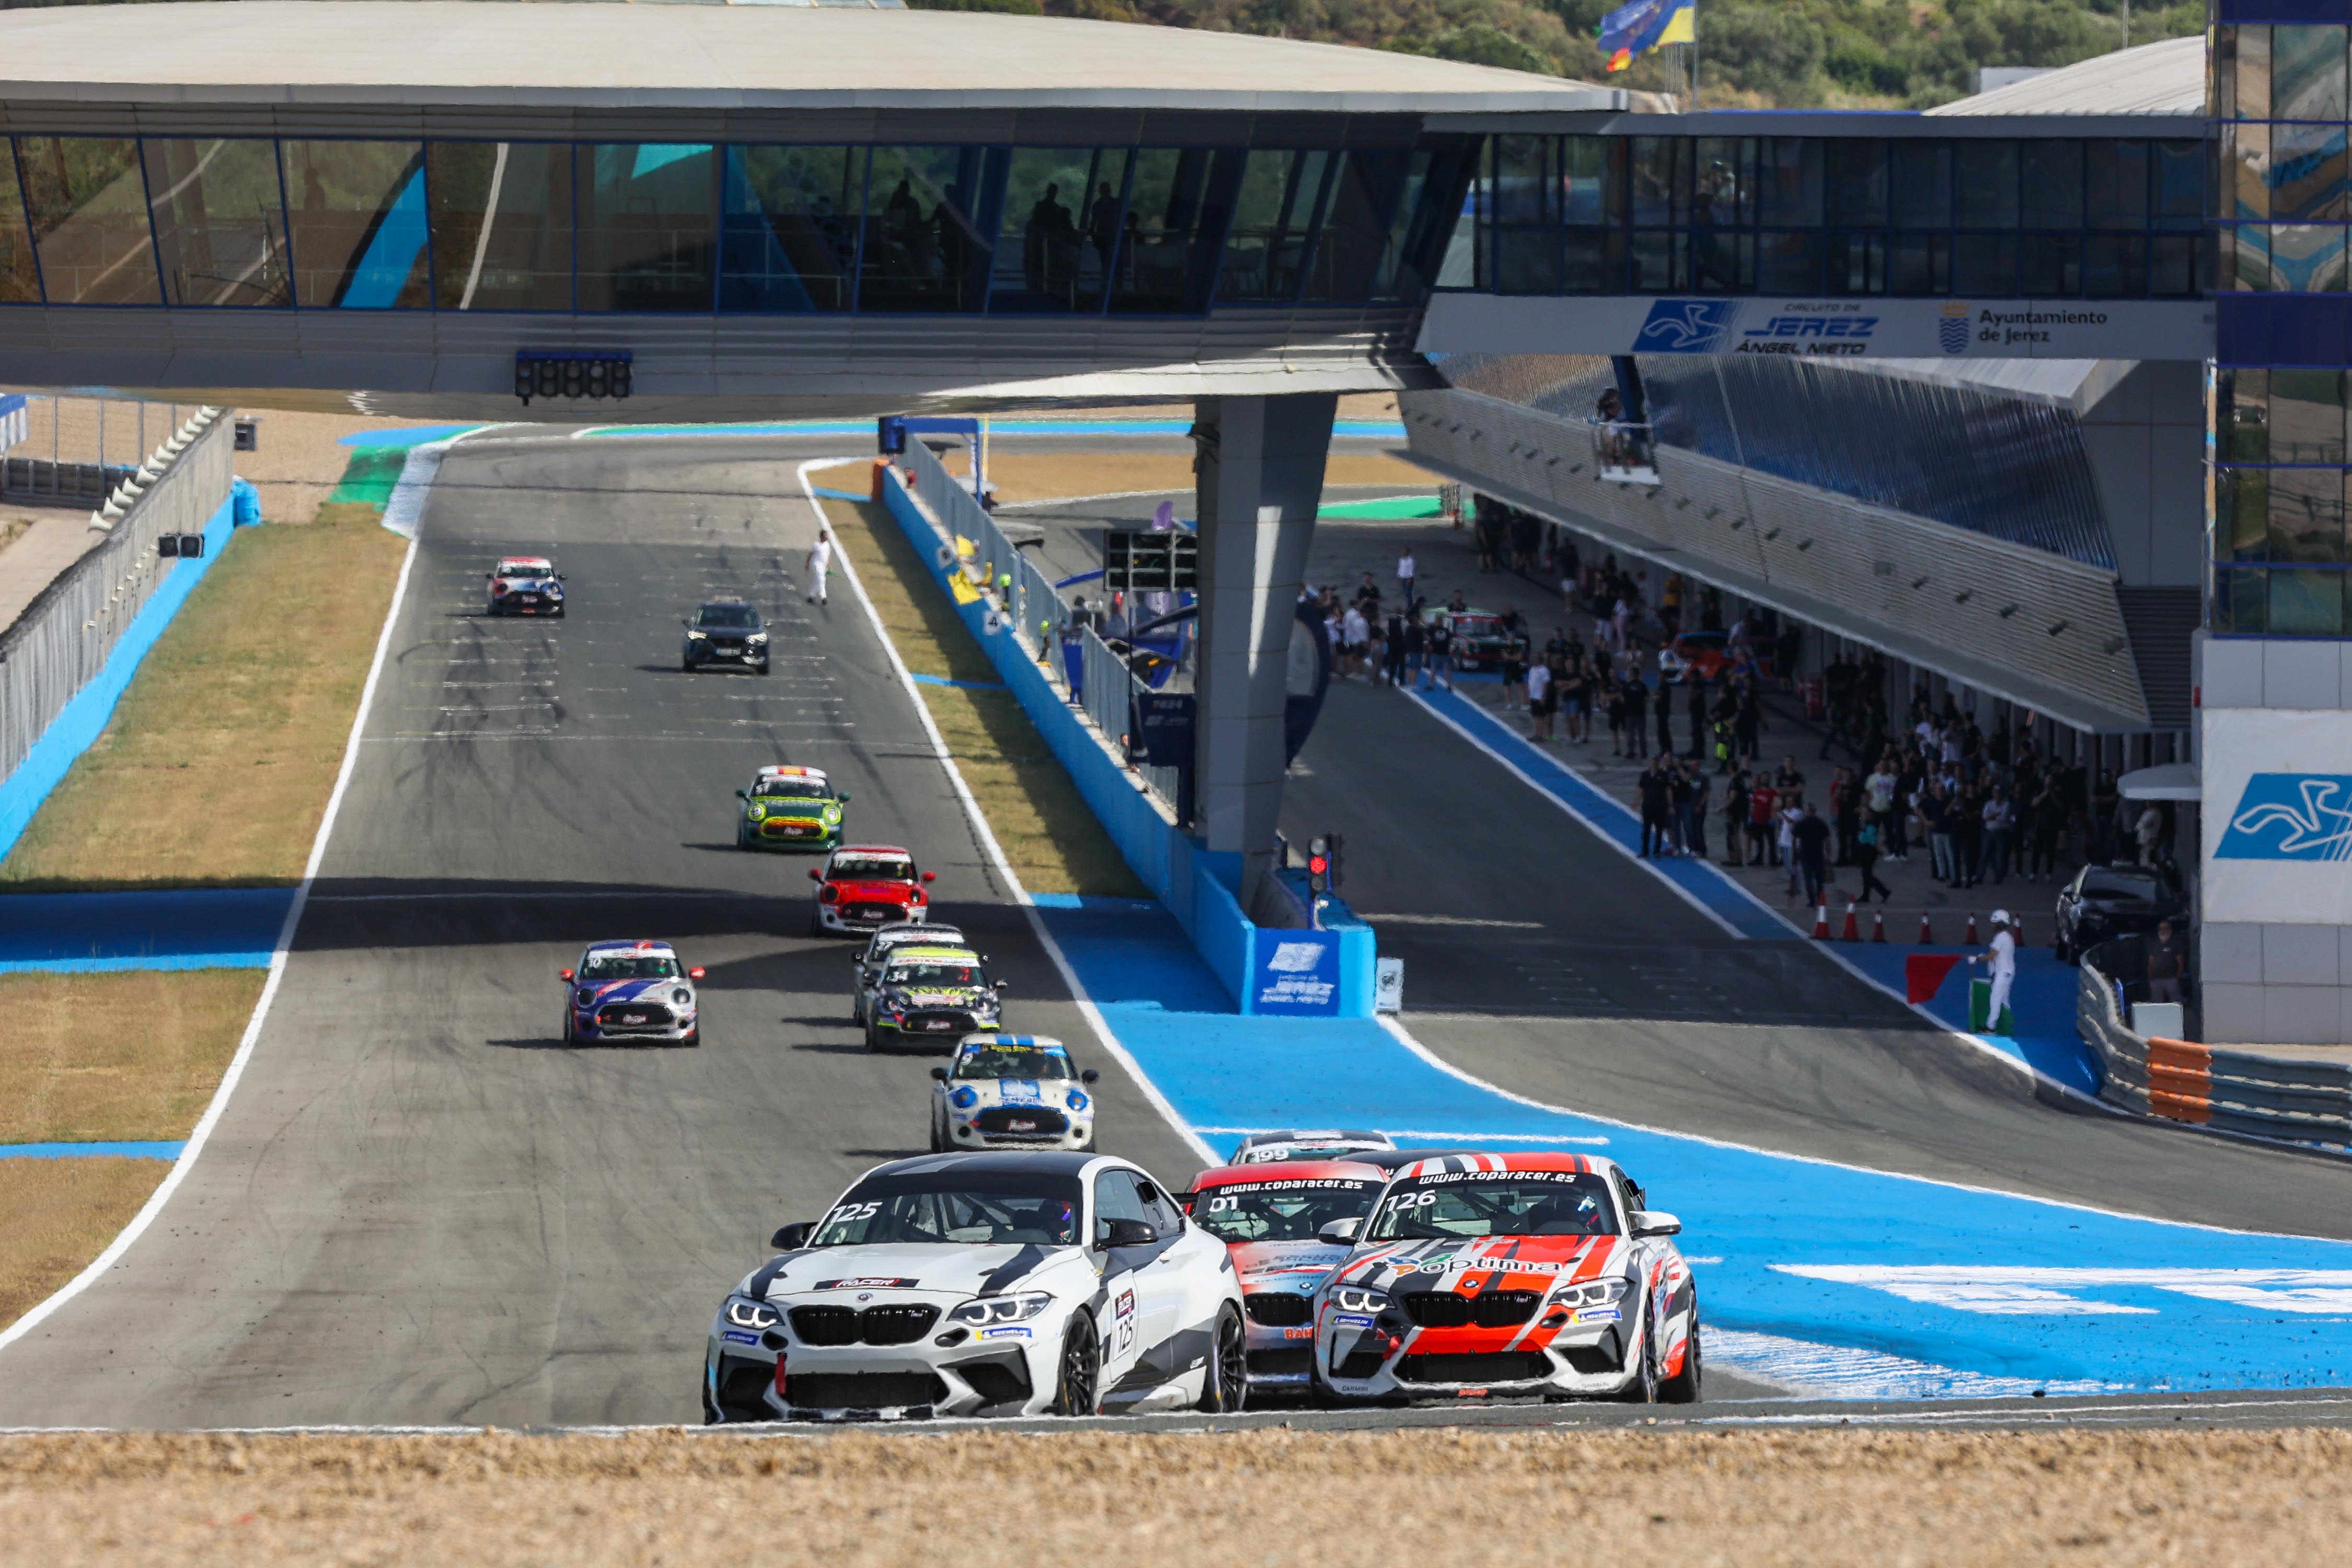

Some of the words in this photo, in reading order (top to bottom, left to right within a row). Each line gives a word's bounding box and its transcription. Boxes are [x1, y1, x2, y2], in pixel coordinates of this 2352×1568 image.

[1842, 303, 1862, 312] DE
[1979, 309, 2108, 327] Ayuntamiento
[1743, 317, 1880, 338] JEREZ
[1979, 328, 2000, 341] de
[2004, 327, 2050, 345] Jerez
[1734, 339, 1801, 355] ÁNGEL
[1806, 342, 1867, 355] NIETO
[1418, 1171, 1576, 1185] www.coparacer.es
[1219, 1180, 1364, 1195] www.coparacer.es
[1387, 1190, 1437, 1213] 126
[830, 1202, 883, 1224] 125
[836, 1279, 895, 1288] RACER
[1118, 1314, 1133, 1353] 125
